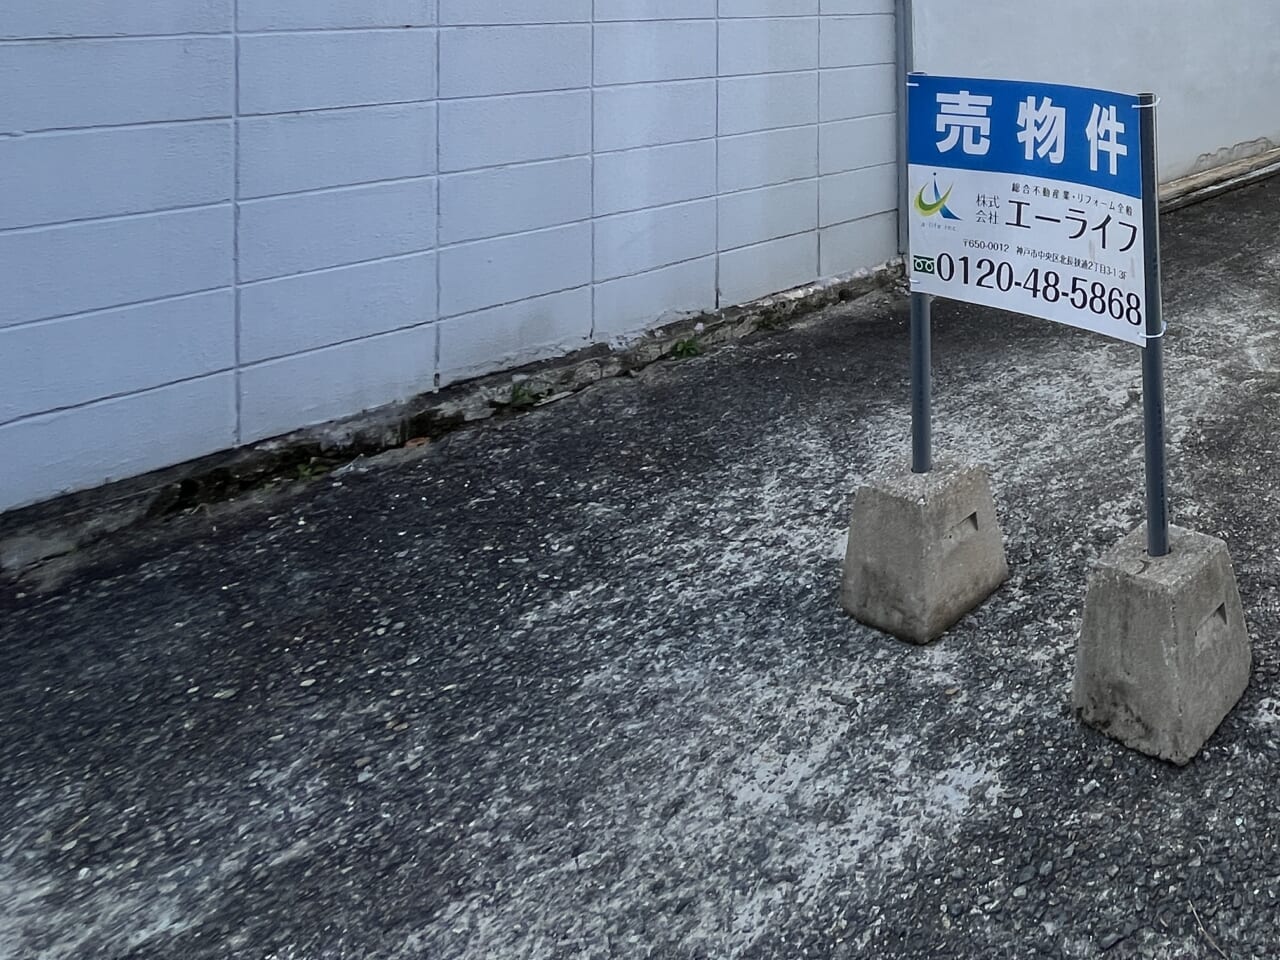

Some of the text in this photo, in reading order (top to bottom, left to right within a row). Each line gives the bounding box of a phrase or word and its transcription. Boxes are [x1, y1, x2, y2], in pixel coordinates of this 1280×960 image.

[935, 90, 1128, 176] 売物件
[1005, 199, 1138, 252] エーライフ
[936, 253, 1143, 327] 0120-48-5868
